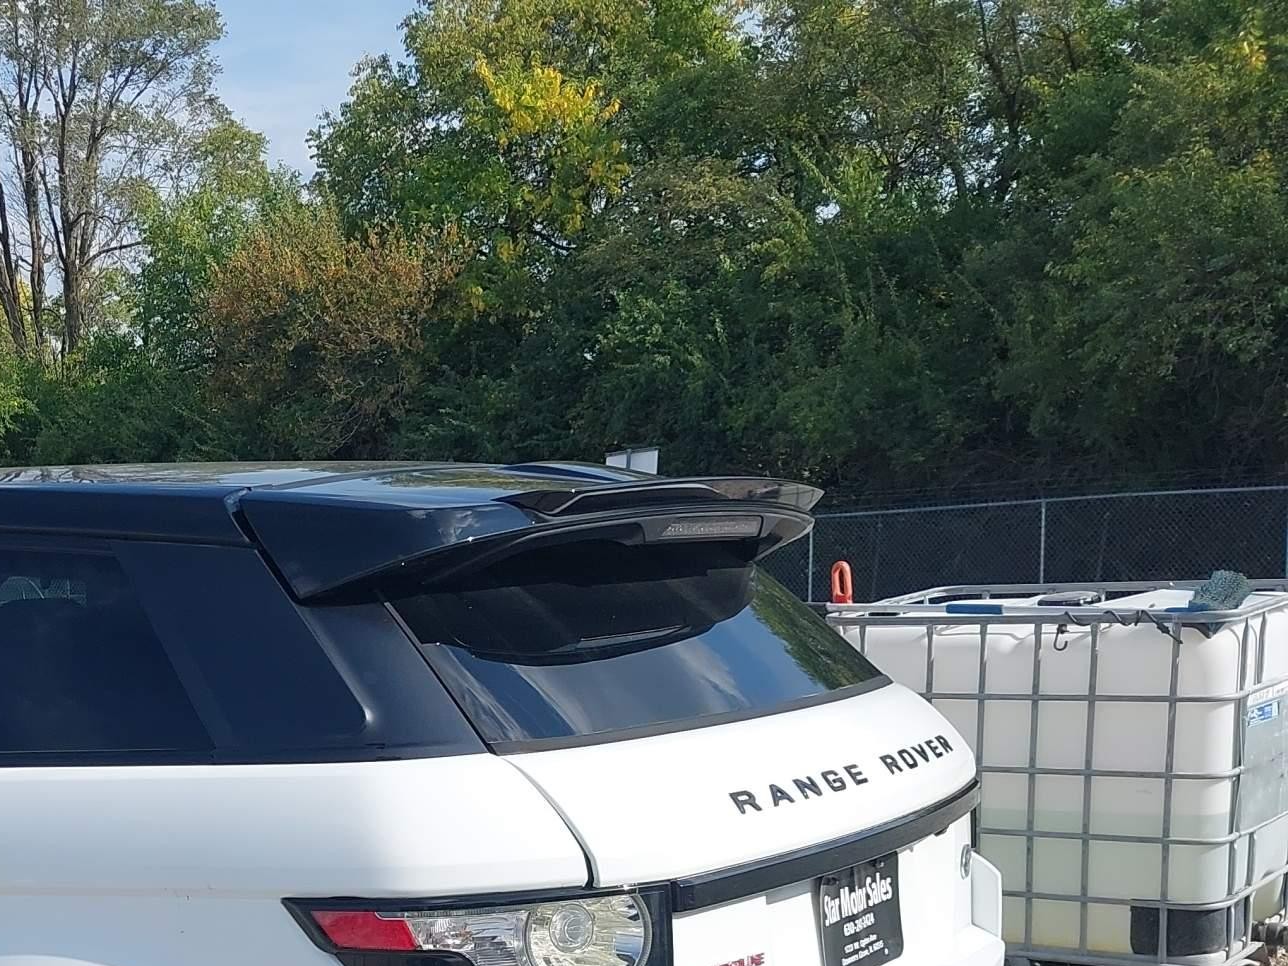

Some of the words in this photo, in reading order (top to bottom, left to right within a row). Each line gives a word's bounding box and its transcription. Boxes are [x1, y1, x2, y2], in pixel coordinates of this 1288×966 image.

[728, 764, 868, 815] RANGE
[878, 734, 954, 775] ROVER
[824, 895, 840, 927] Star
[840, 886, 867, 918] Motor
[866, 872, 893, 907] Sales
